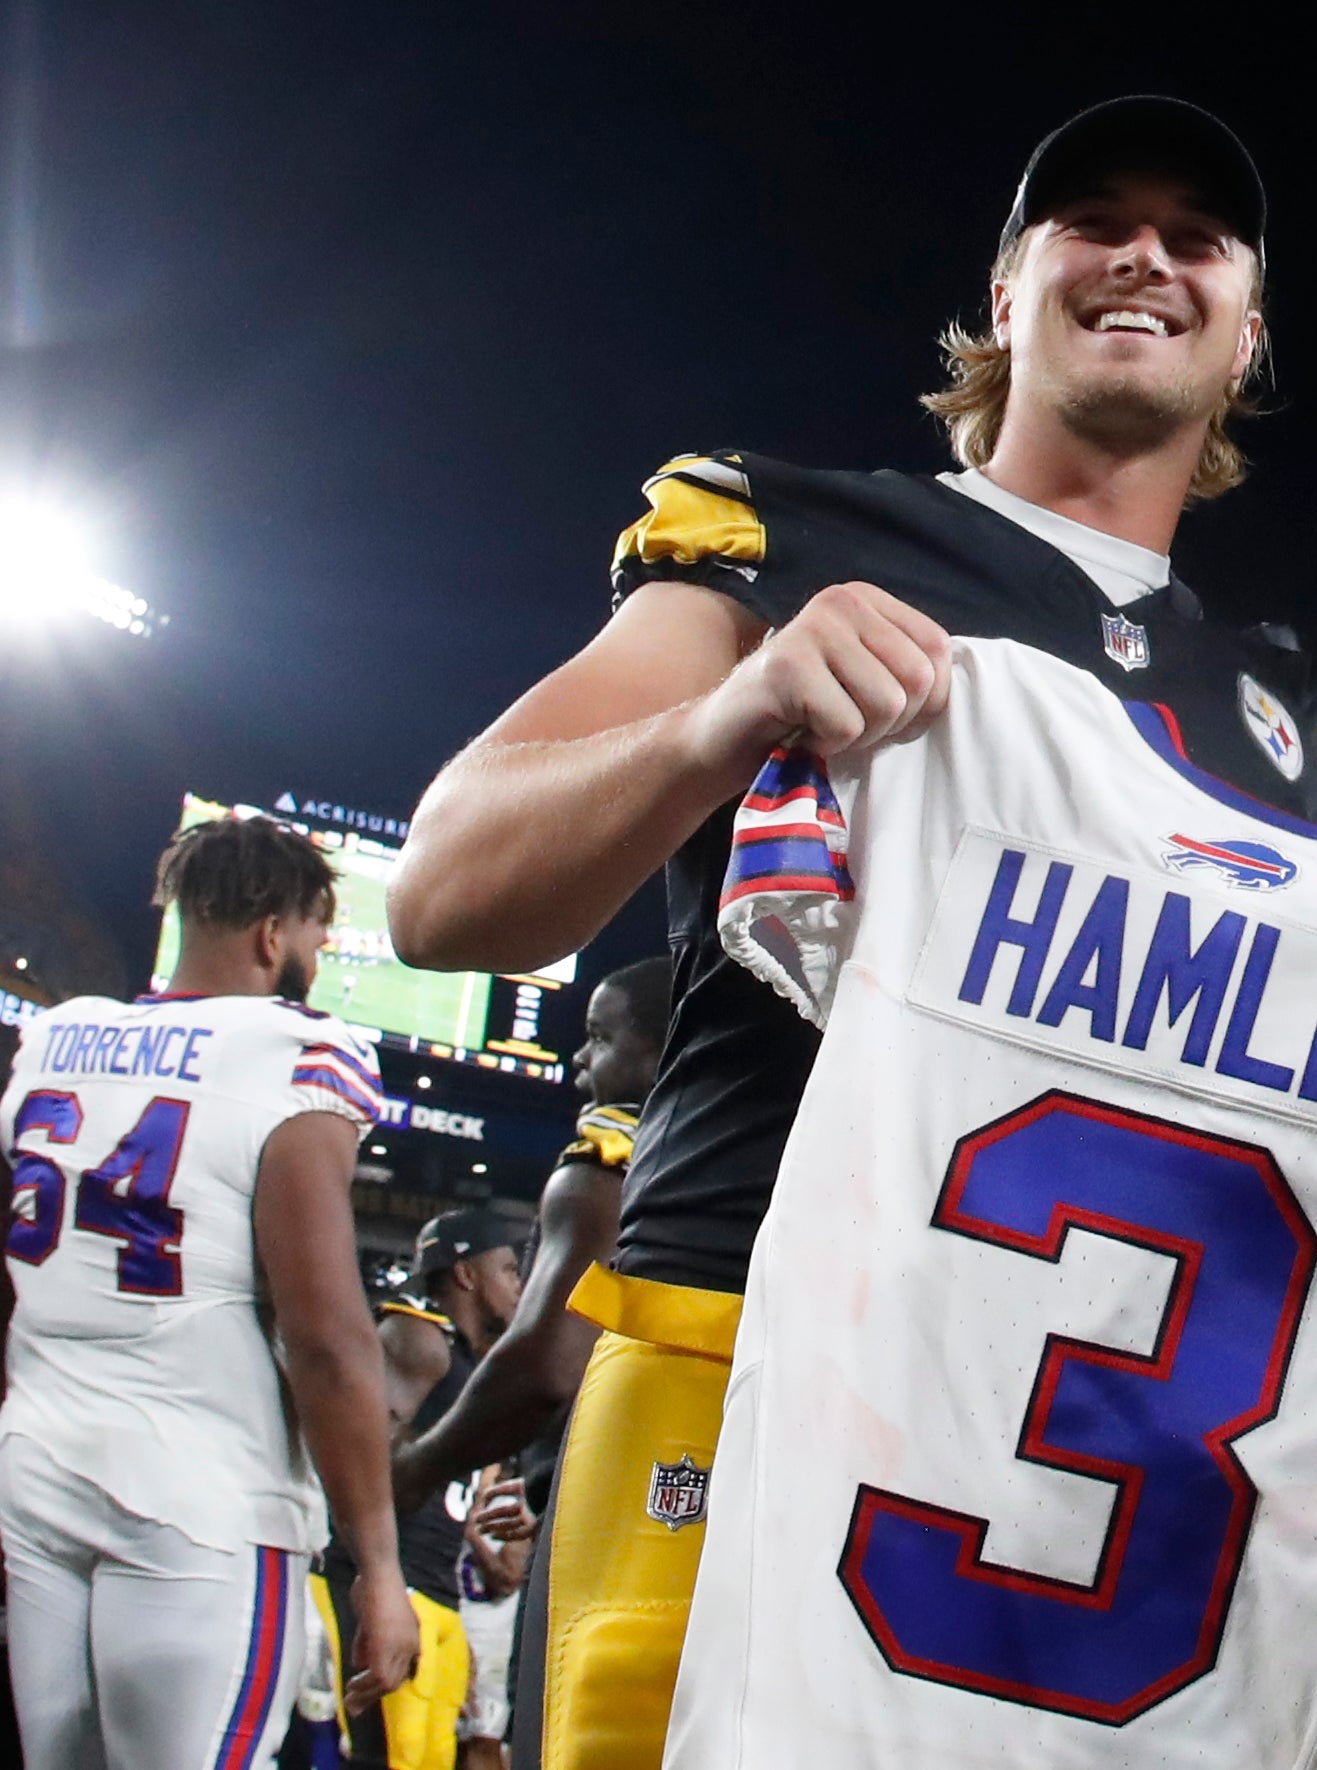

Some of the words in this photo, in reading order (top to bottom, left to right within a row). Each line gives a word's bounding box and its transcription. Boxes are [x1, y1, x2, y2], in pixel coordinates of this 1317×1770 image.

[1111, 635, 1143, 658] NFL
[301, 799, 409, 839] ACRISURE
[40, 1023, 214, 1083] TORRENCE
[410, 1104, 486, 1141] DECK
[5, 1088, 192, 1296] 64
[657, 1488, 699, 1514] NFL
